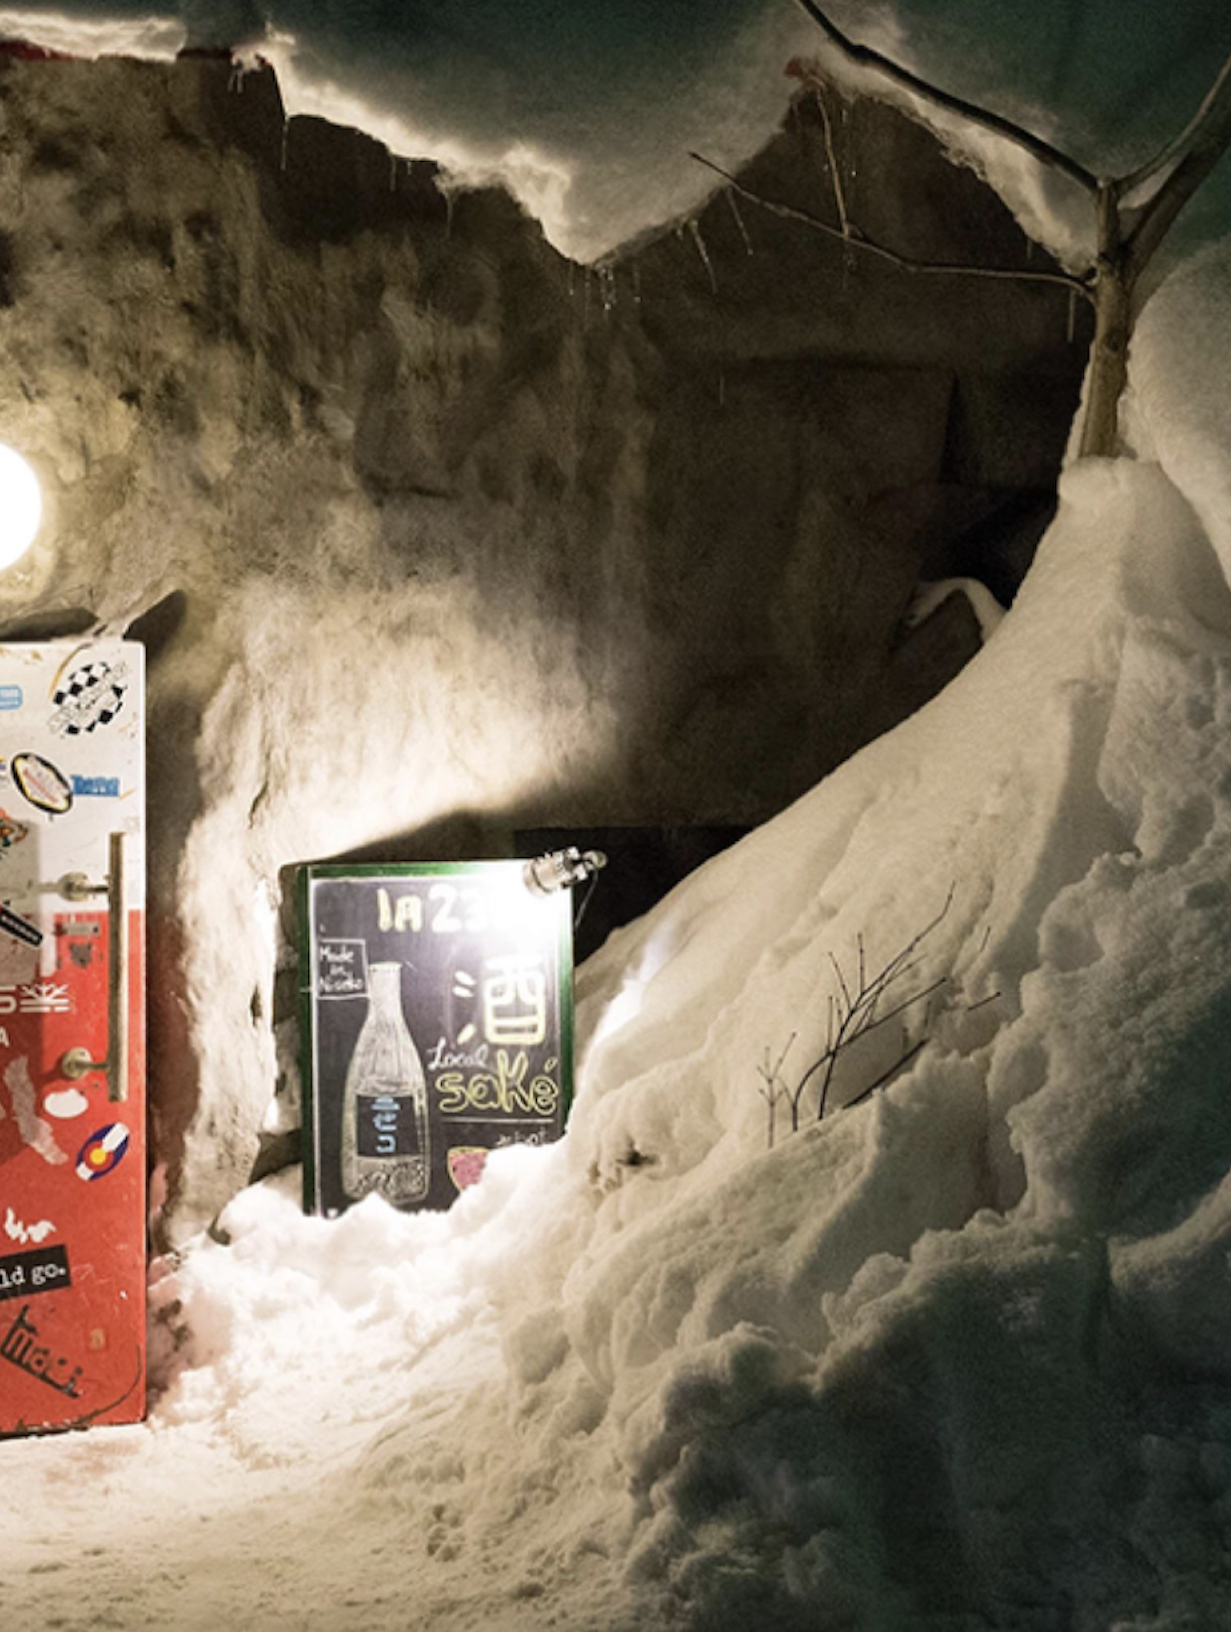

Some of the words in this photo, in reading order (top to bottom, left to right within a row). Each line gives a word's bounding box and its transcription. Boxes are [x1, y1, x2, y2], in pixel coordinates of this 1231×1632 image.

[320, 945, 354, 964] Made
[427, 1037, 488, 1070] Local
[31, 1263, 66, 1285] go.
